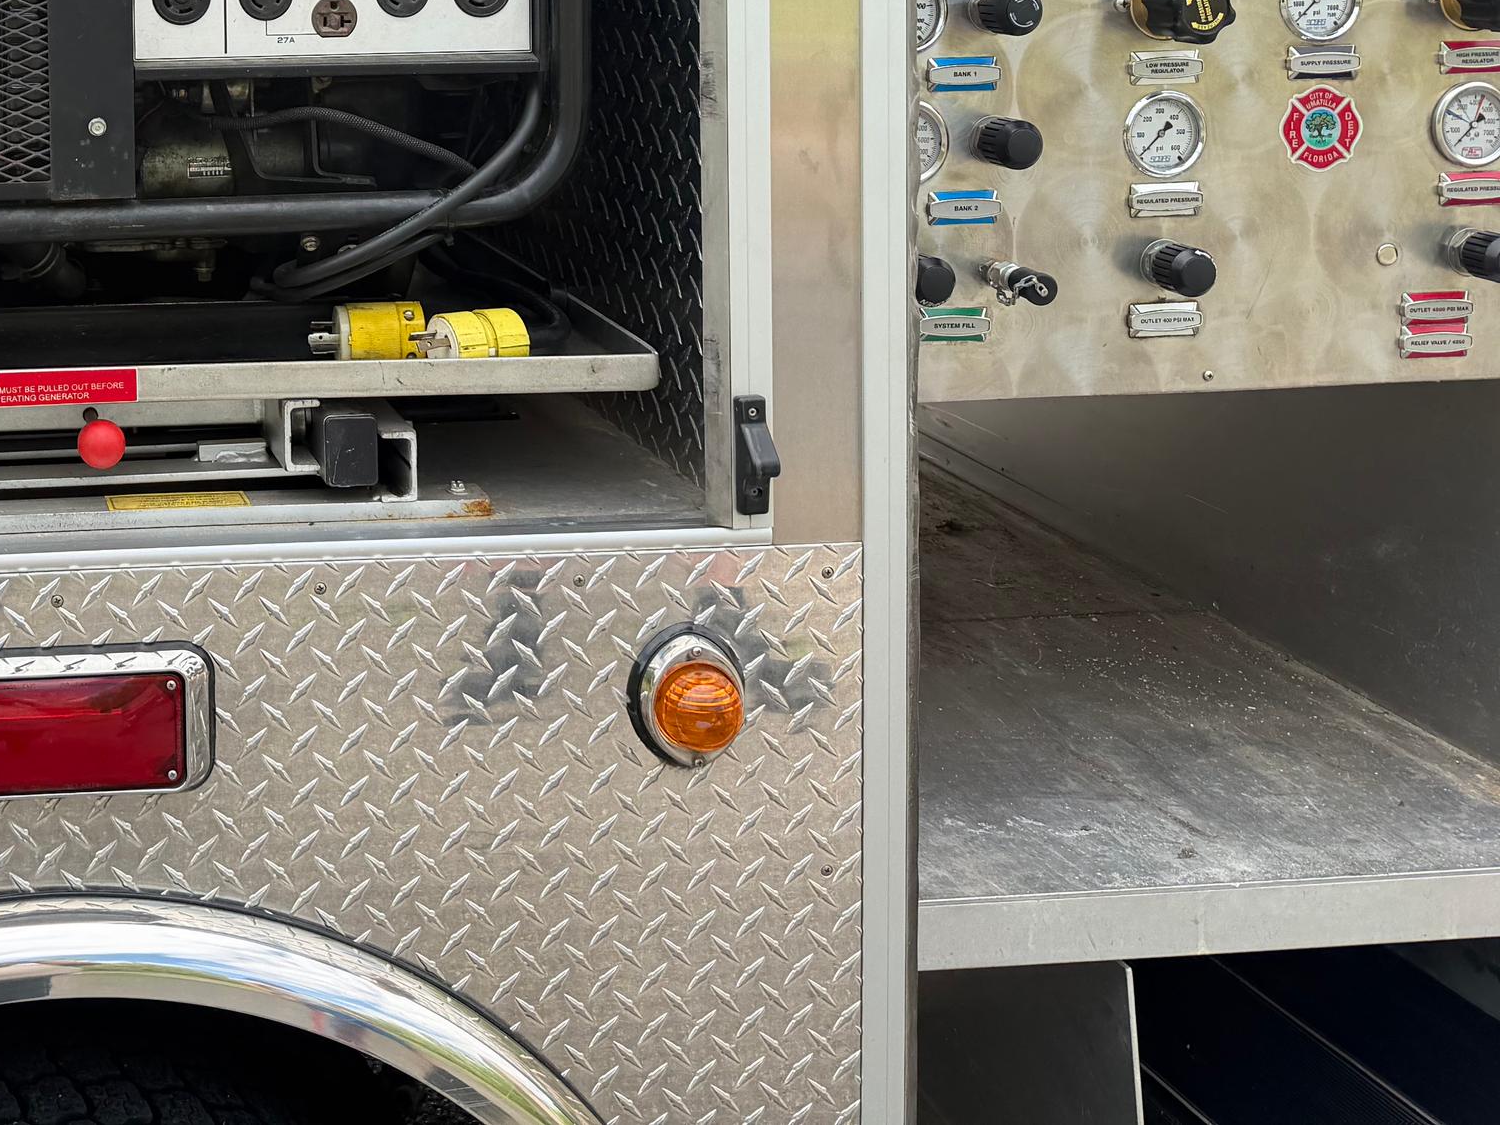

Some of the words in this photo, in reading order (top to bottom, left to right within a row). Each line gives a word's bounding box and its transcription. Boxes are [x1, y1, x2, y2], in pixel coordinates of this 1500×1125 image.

[277, 36, 296, 44] 27A
[1309, 92, 1323, 100] CITY
[1325, 92, 1333, 100] OF
[1305, 98, 1337, 109] UMATILLA
[1136, 131, 1145, 139] 100
[1289, 112, 1299, 148] FIRE
[1344, 112, 1354, 147] DEPT
[1155, 145, 1164, 153] psi
[1303, 150, 1339, 163] FLORIDA
[0, 386, 23, 395] MUST
[24, 385, 36, 394] BE
[37, 383, 69, 393] PULLED
[72, 383, 90, 391] OUT
[91, 381, 125, 391] BEFORE
[38, 391, 90, 402] GENERATOR
